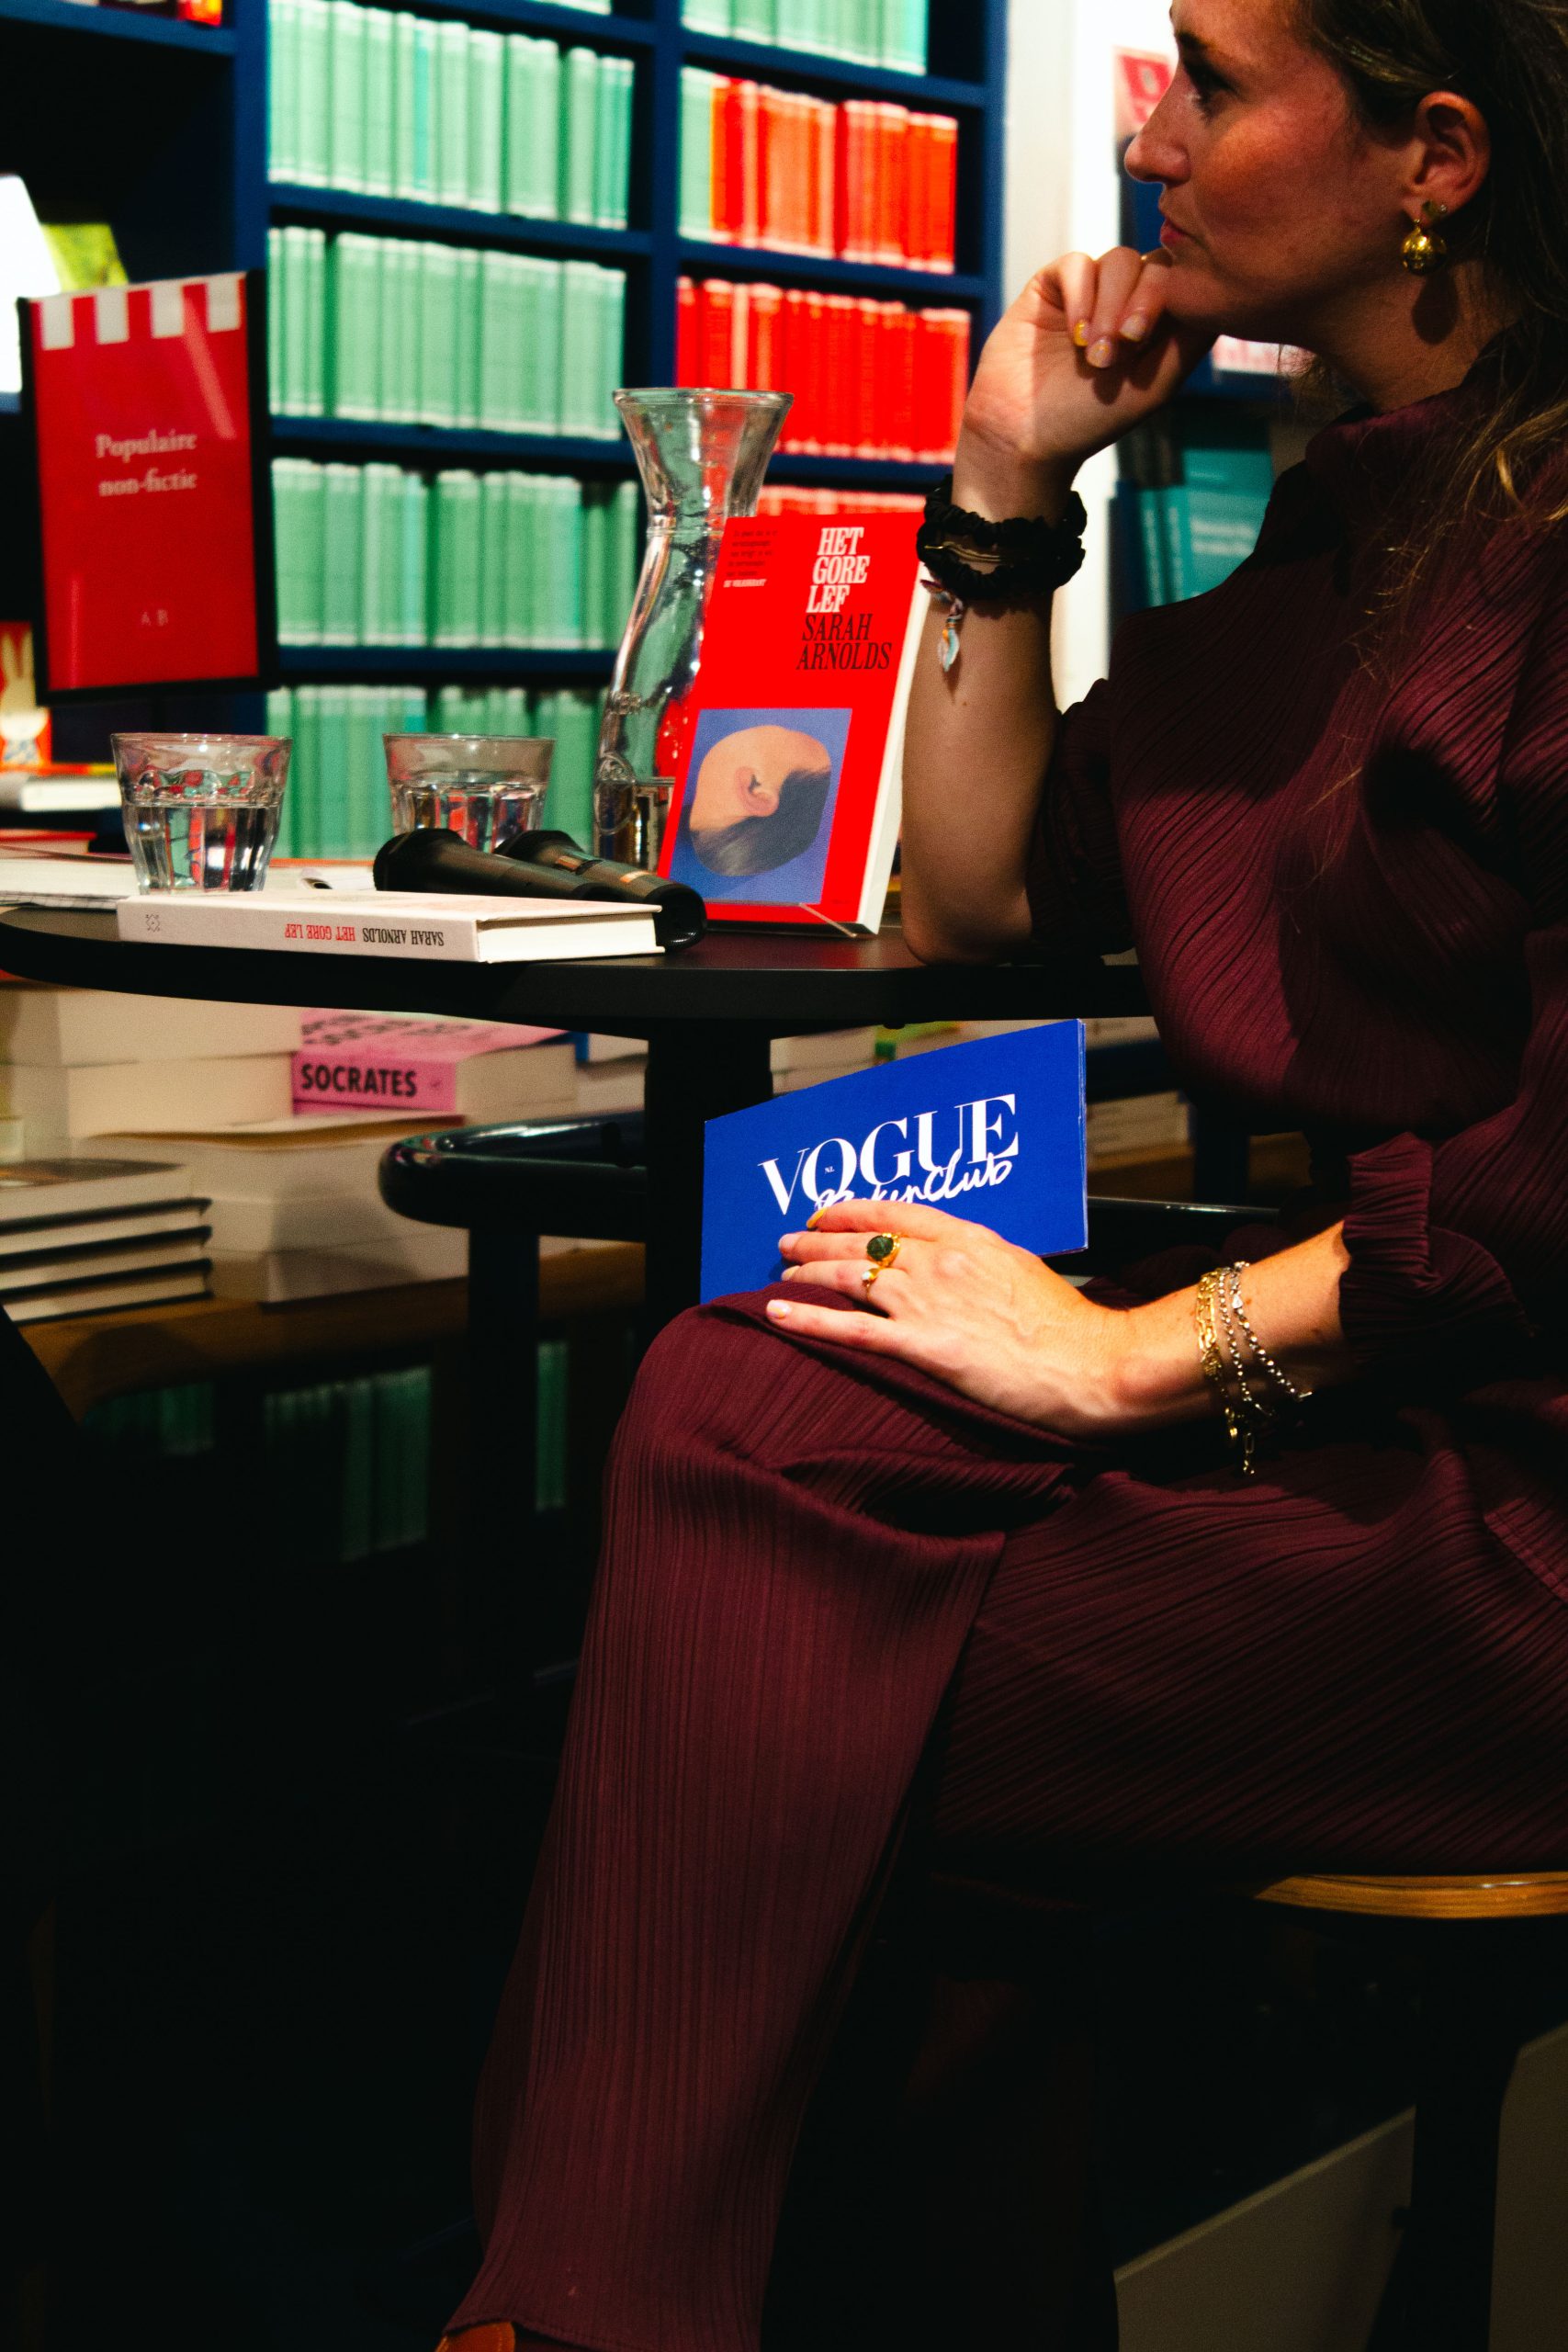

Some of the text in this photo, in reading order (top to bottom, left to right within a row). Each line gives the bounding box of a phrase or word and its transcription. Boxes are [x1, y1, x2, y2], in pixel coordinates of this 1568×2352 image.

[95, 428, 197, 463] Populaire
[98, 467, 197, 497] non-fictie
[817, 526, 864, 556] HET
[812, 555, 871, 584] GORE
[806, 584, 851, 614] LEF
[802, 614, 873, 641] SARAH
[795, 642, 892, 670] ARNOLDS
[307, 924, 332, 940] GORE
[335, 926, 355, 941] HET
[363, 927, 407, 944] ARNOLDS
[411, 931, 445, 946] SARAH
[301, 1063, 417, 1097] SOCRATES
[758, 1093, 1019, 1216] VOGUE
[824, 1166, 835, 1174] NL
